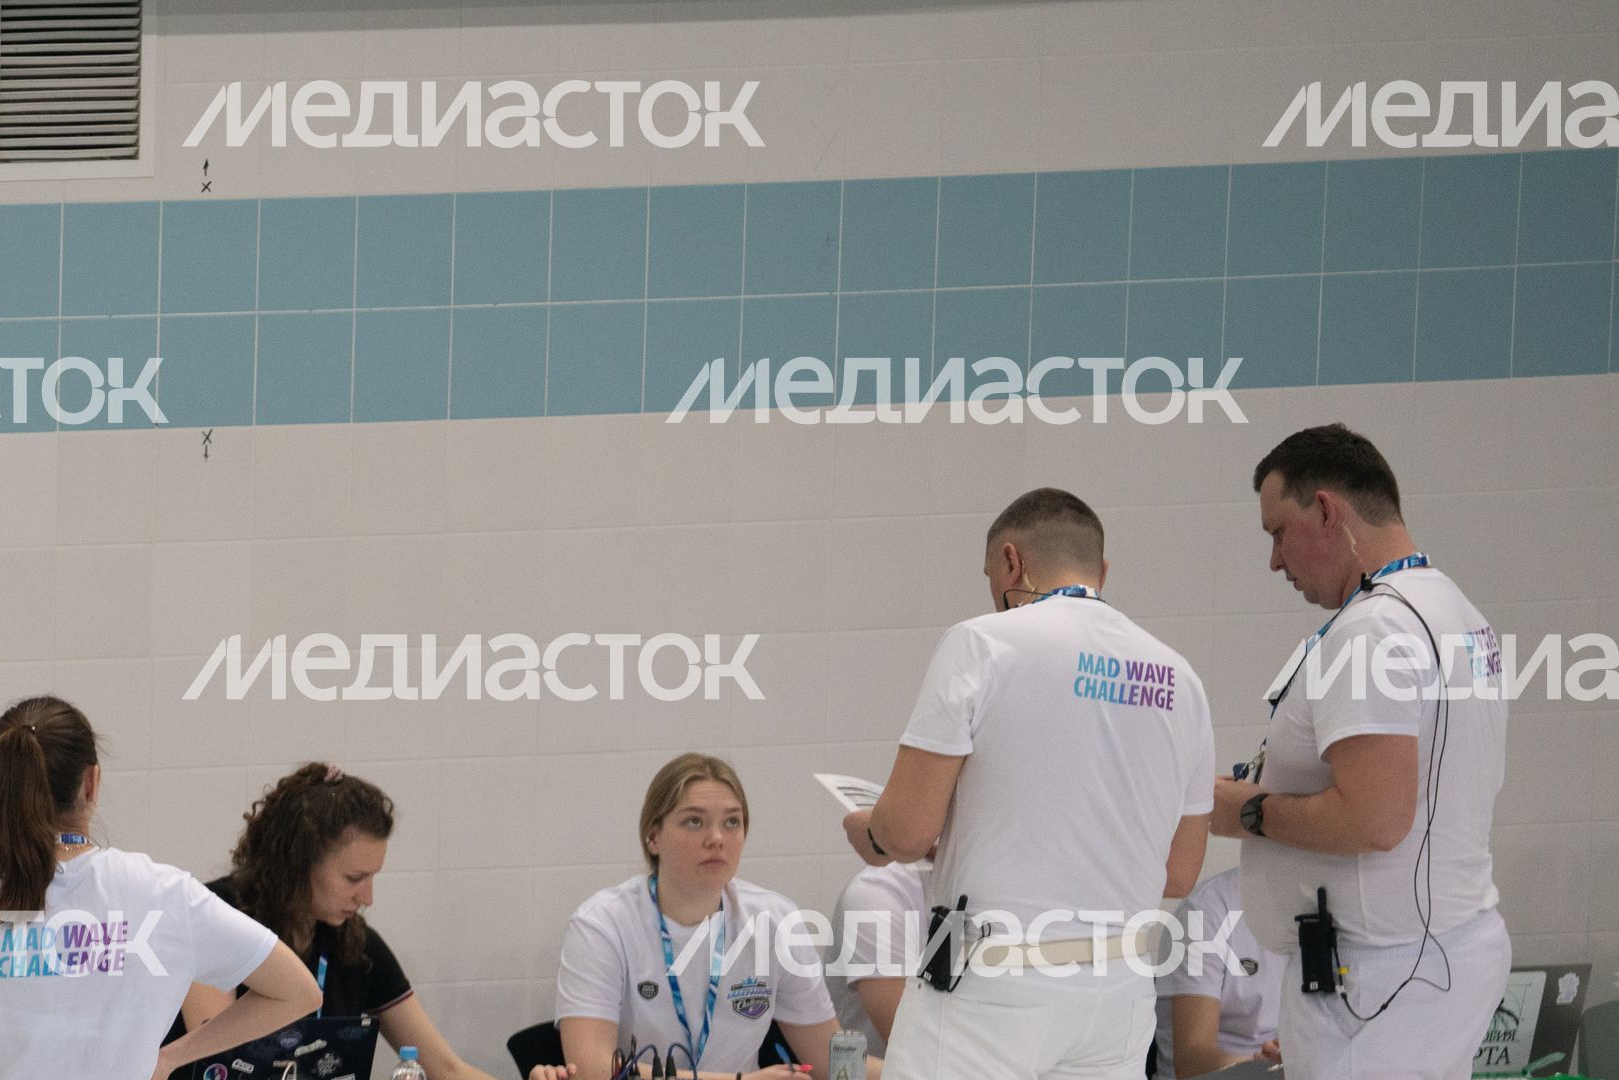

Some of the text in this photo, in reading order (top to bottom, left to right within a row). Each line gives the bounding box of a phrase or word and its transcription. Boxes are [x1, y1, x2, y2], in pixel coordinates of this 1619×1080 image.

[1078, 651, 1175, 688] MAD WAVE
[1073, 675, 1175, 711] CHALLENGE
[1, 921, 128, 952] MAD WAVE
